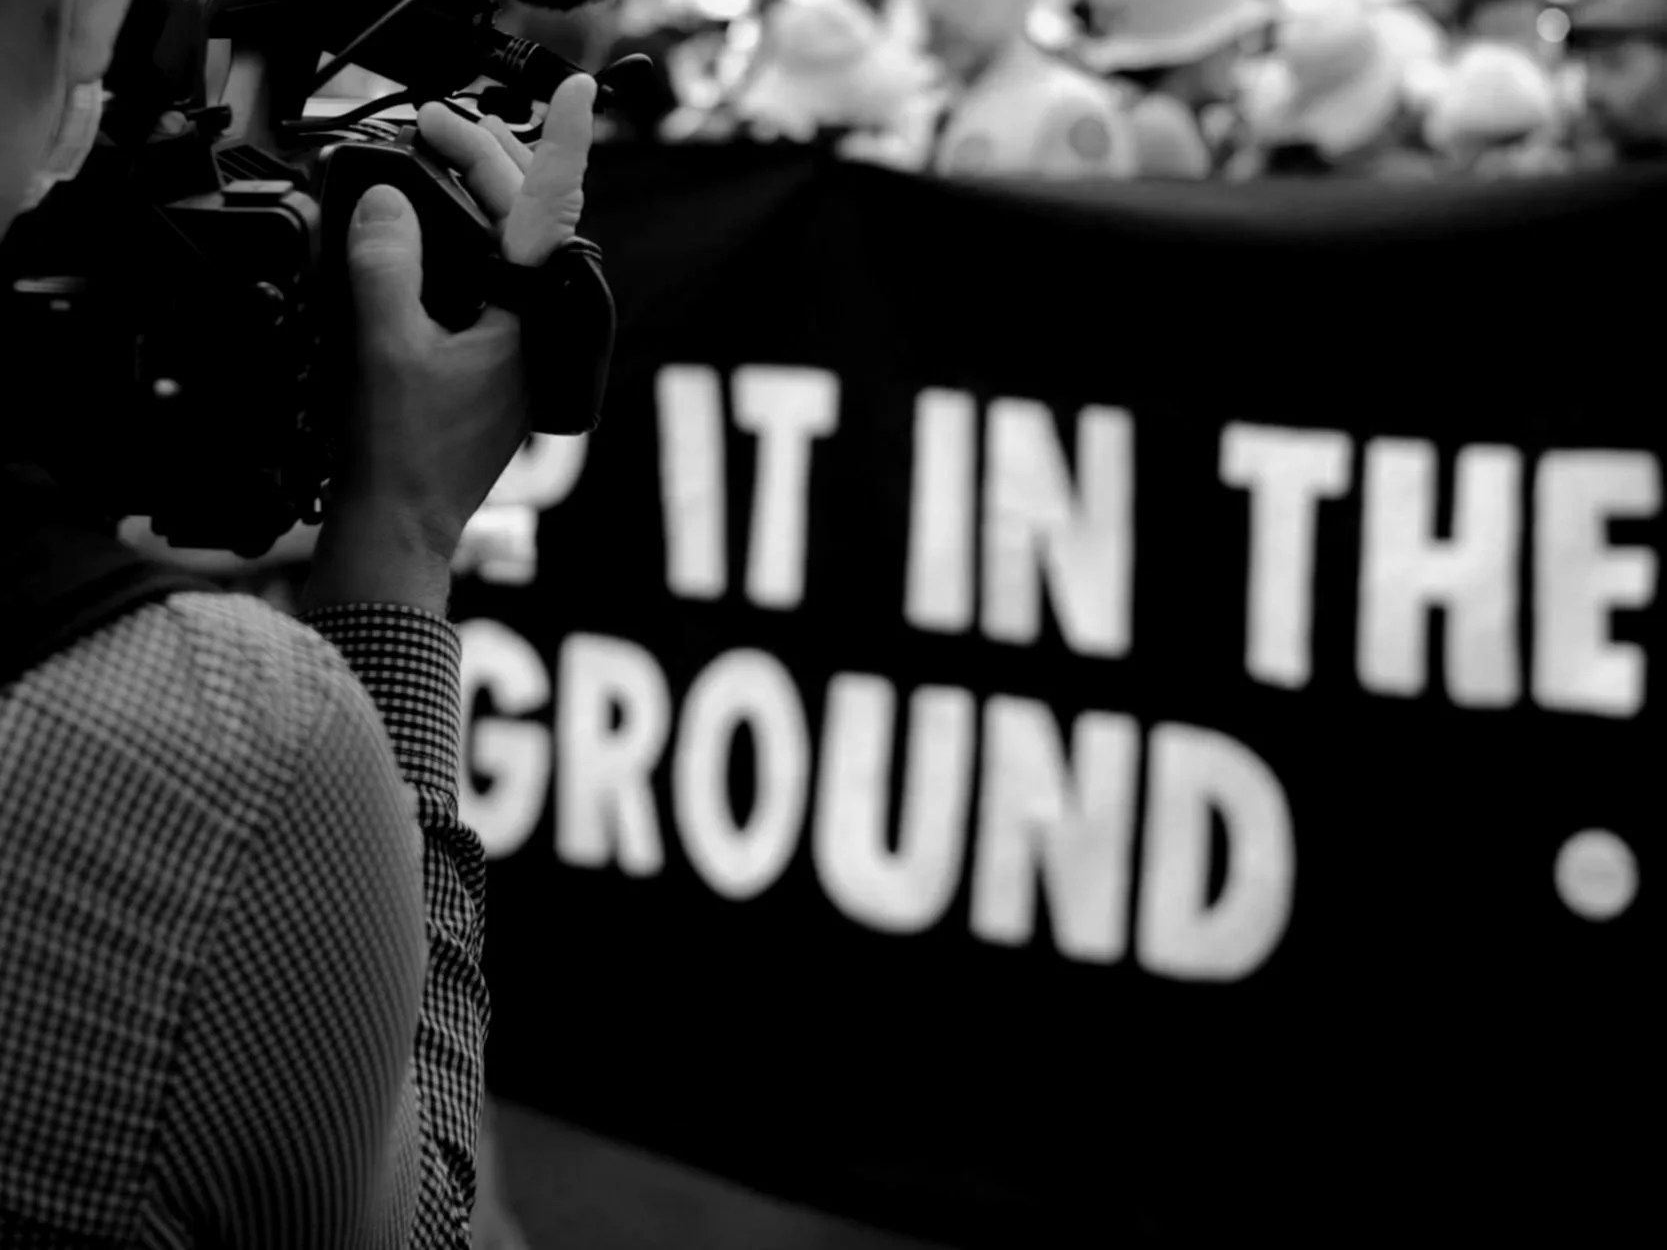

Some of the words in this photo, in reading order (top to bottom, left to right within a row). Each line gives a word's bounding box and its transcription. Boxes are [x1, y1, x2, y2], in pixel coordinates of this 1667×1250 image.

[656, 365, 840, 608] IT
[905, 388, 1134, 657] IN
[1219, 422, 1661, 717] THE
[457, 618, 1295, 981] GROUND
